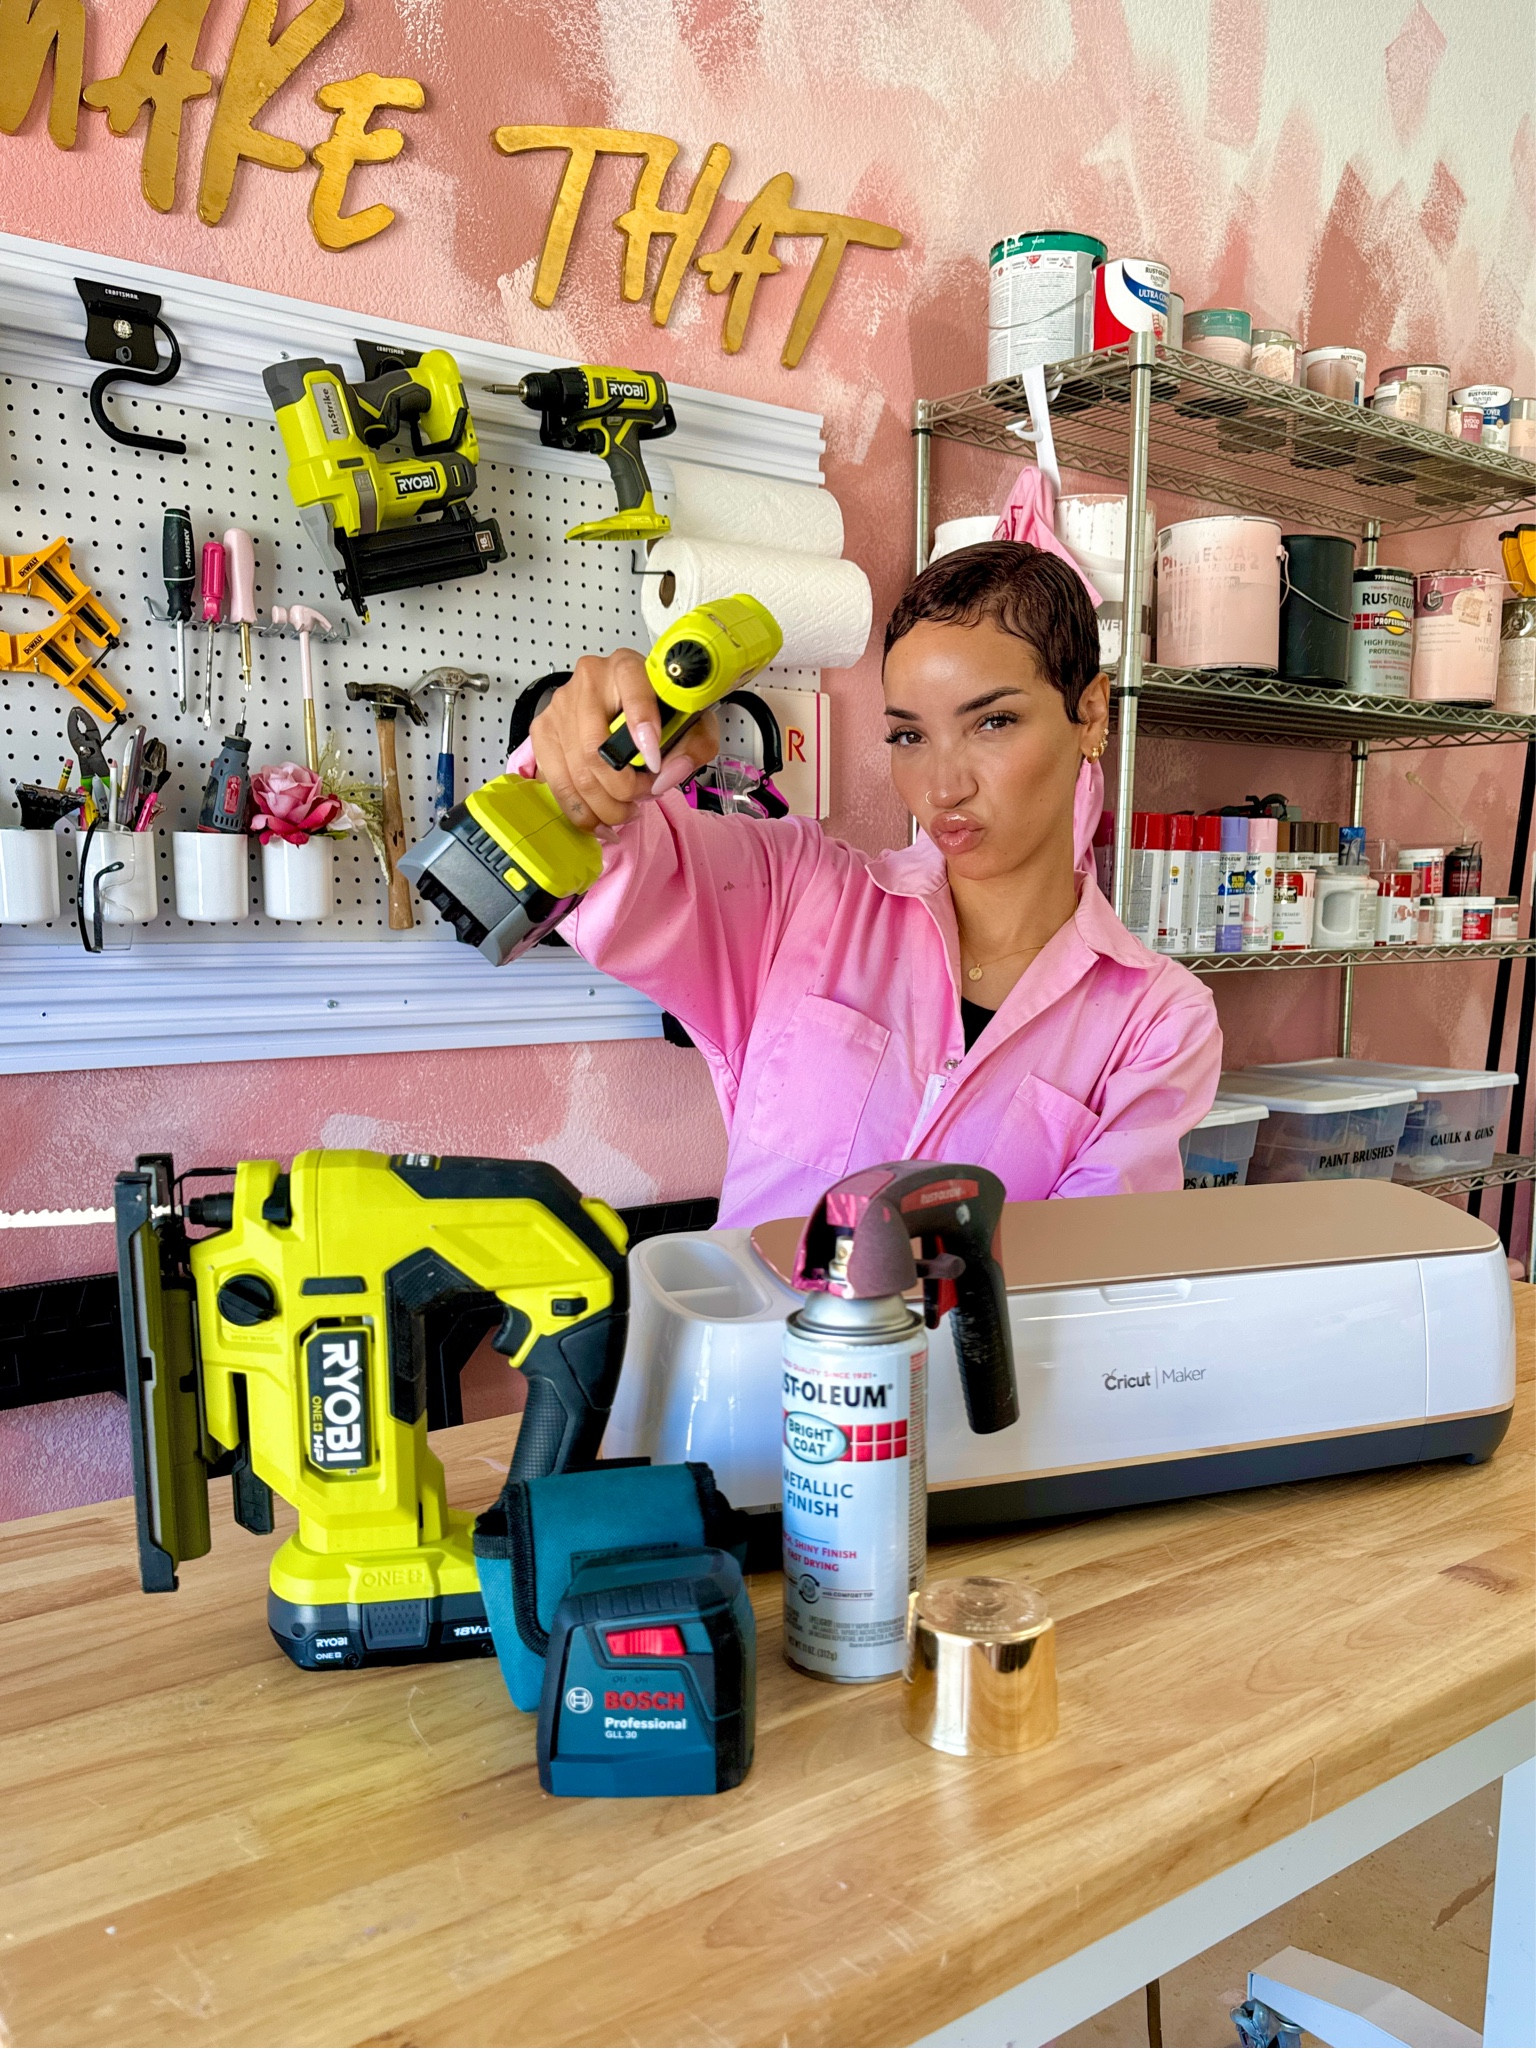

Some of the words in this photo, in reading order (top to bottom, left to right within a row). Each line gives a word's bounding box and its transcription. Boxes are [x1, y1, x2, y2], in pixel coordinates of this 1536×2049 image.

[490, 124, 902, 369] THAT
[104, 288, 139, 300] CRAFTSMAN
[1138, 288, 1158, 300] ULTRA
[376, 345, 405, 356] CRAFTSMAN
[608, 382, 644, 397] RYOBI
[323, 388, 340, 435] AirStrike
[397, 475, 434, 493] RYOBI
[1374, 617, 1411, 629] PROFESSIONAL
[1364, 639, 1383, 647] HIGH
[785, 726, 807, 763] R
[1430, 1132, 1462, 1147] CAULK
[1464, 1131, 1472, 1141] &
[1474, 1125, 1495, 1140] GUNS
[1319, 1153, 1349, 1169] PAINT
[1351, 1144, 1396, 1162] BRUSHES
[1200, 1176, 1208, 1189] &
[1212, 1171, 1240, 1187] TAPE
[1102, 1368, 1151, 1391] Cricut
[1162, 1366, 1207, 1384] Maker
[321, 1339, 362, 1462] RYOBI
[788, 1418, 834, 1443] BRIGHT
[313, 1434, 325, 1462] HP
[793, 1437, 826, 1458] COAT
[787, 1490, 839, 1518] FINISH
[794, 1538, 819, 1555] SHINY
[822, 1547, 858, 1560] FINISH
[804, 1556, 840, 1572] DRYING
[315, 1636, 348, 1649] RYOBI
[817, 1647, 838, 1662] (312g)
[604, 1690, 686, 1711] BOSCH
[604, 1716, 687, 1730] Professional
[605, 1730, 625, 1739] GLL
[625, 1730, 638, 1739] 30
